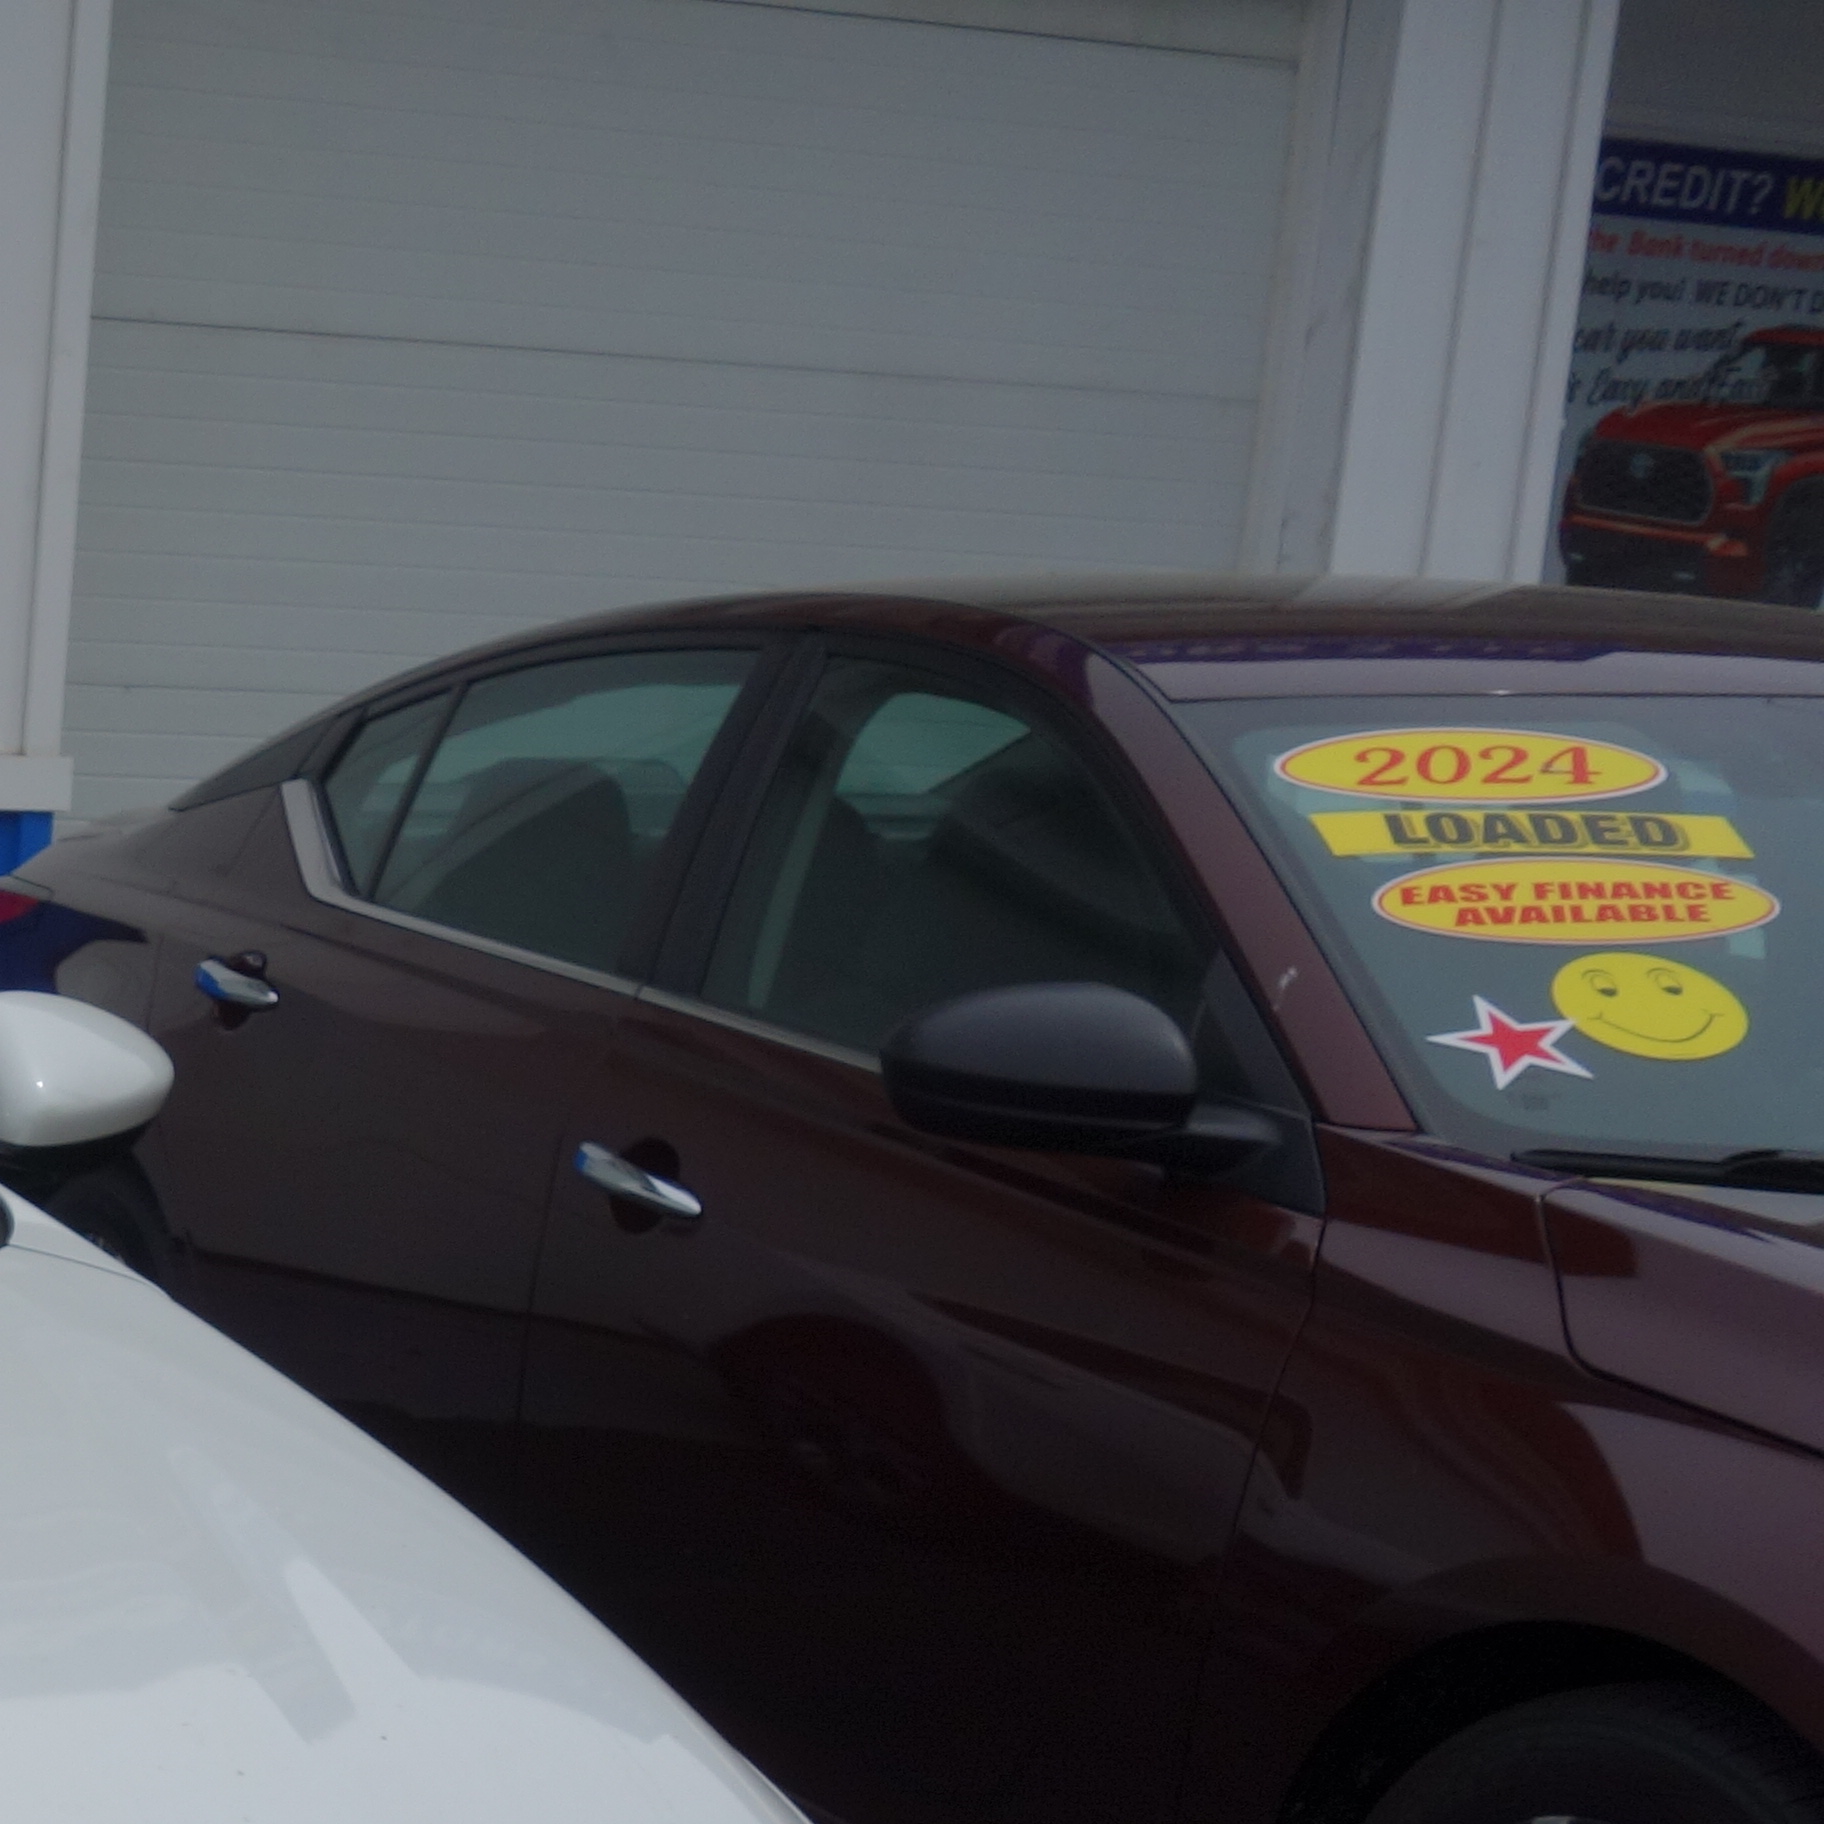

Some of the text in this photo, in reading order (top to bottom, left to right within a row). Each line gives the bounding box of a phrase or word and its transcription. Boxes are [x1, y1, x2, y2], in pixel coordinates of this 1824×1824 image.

[1593, 157, 1773, 214] CREDIT?
[1353, 744, 1602, 787] 2024
[1382, 812, 1689, 850] LOADED
[1400, 880, 1737, 907] EASY FINANCE
[1453, 902, 1713, 928] AVAILABLE
